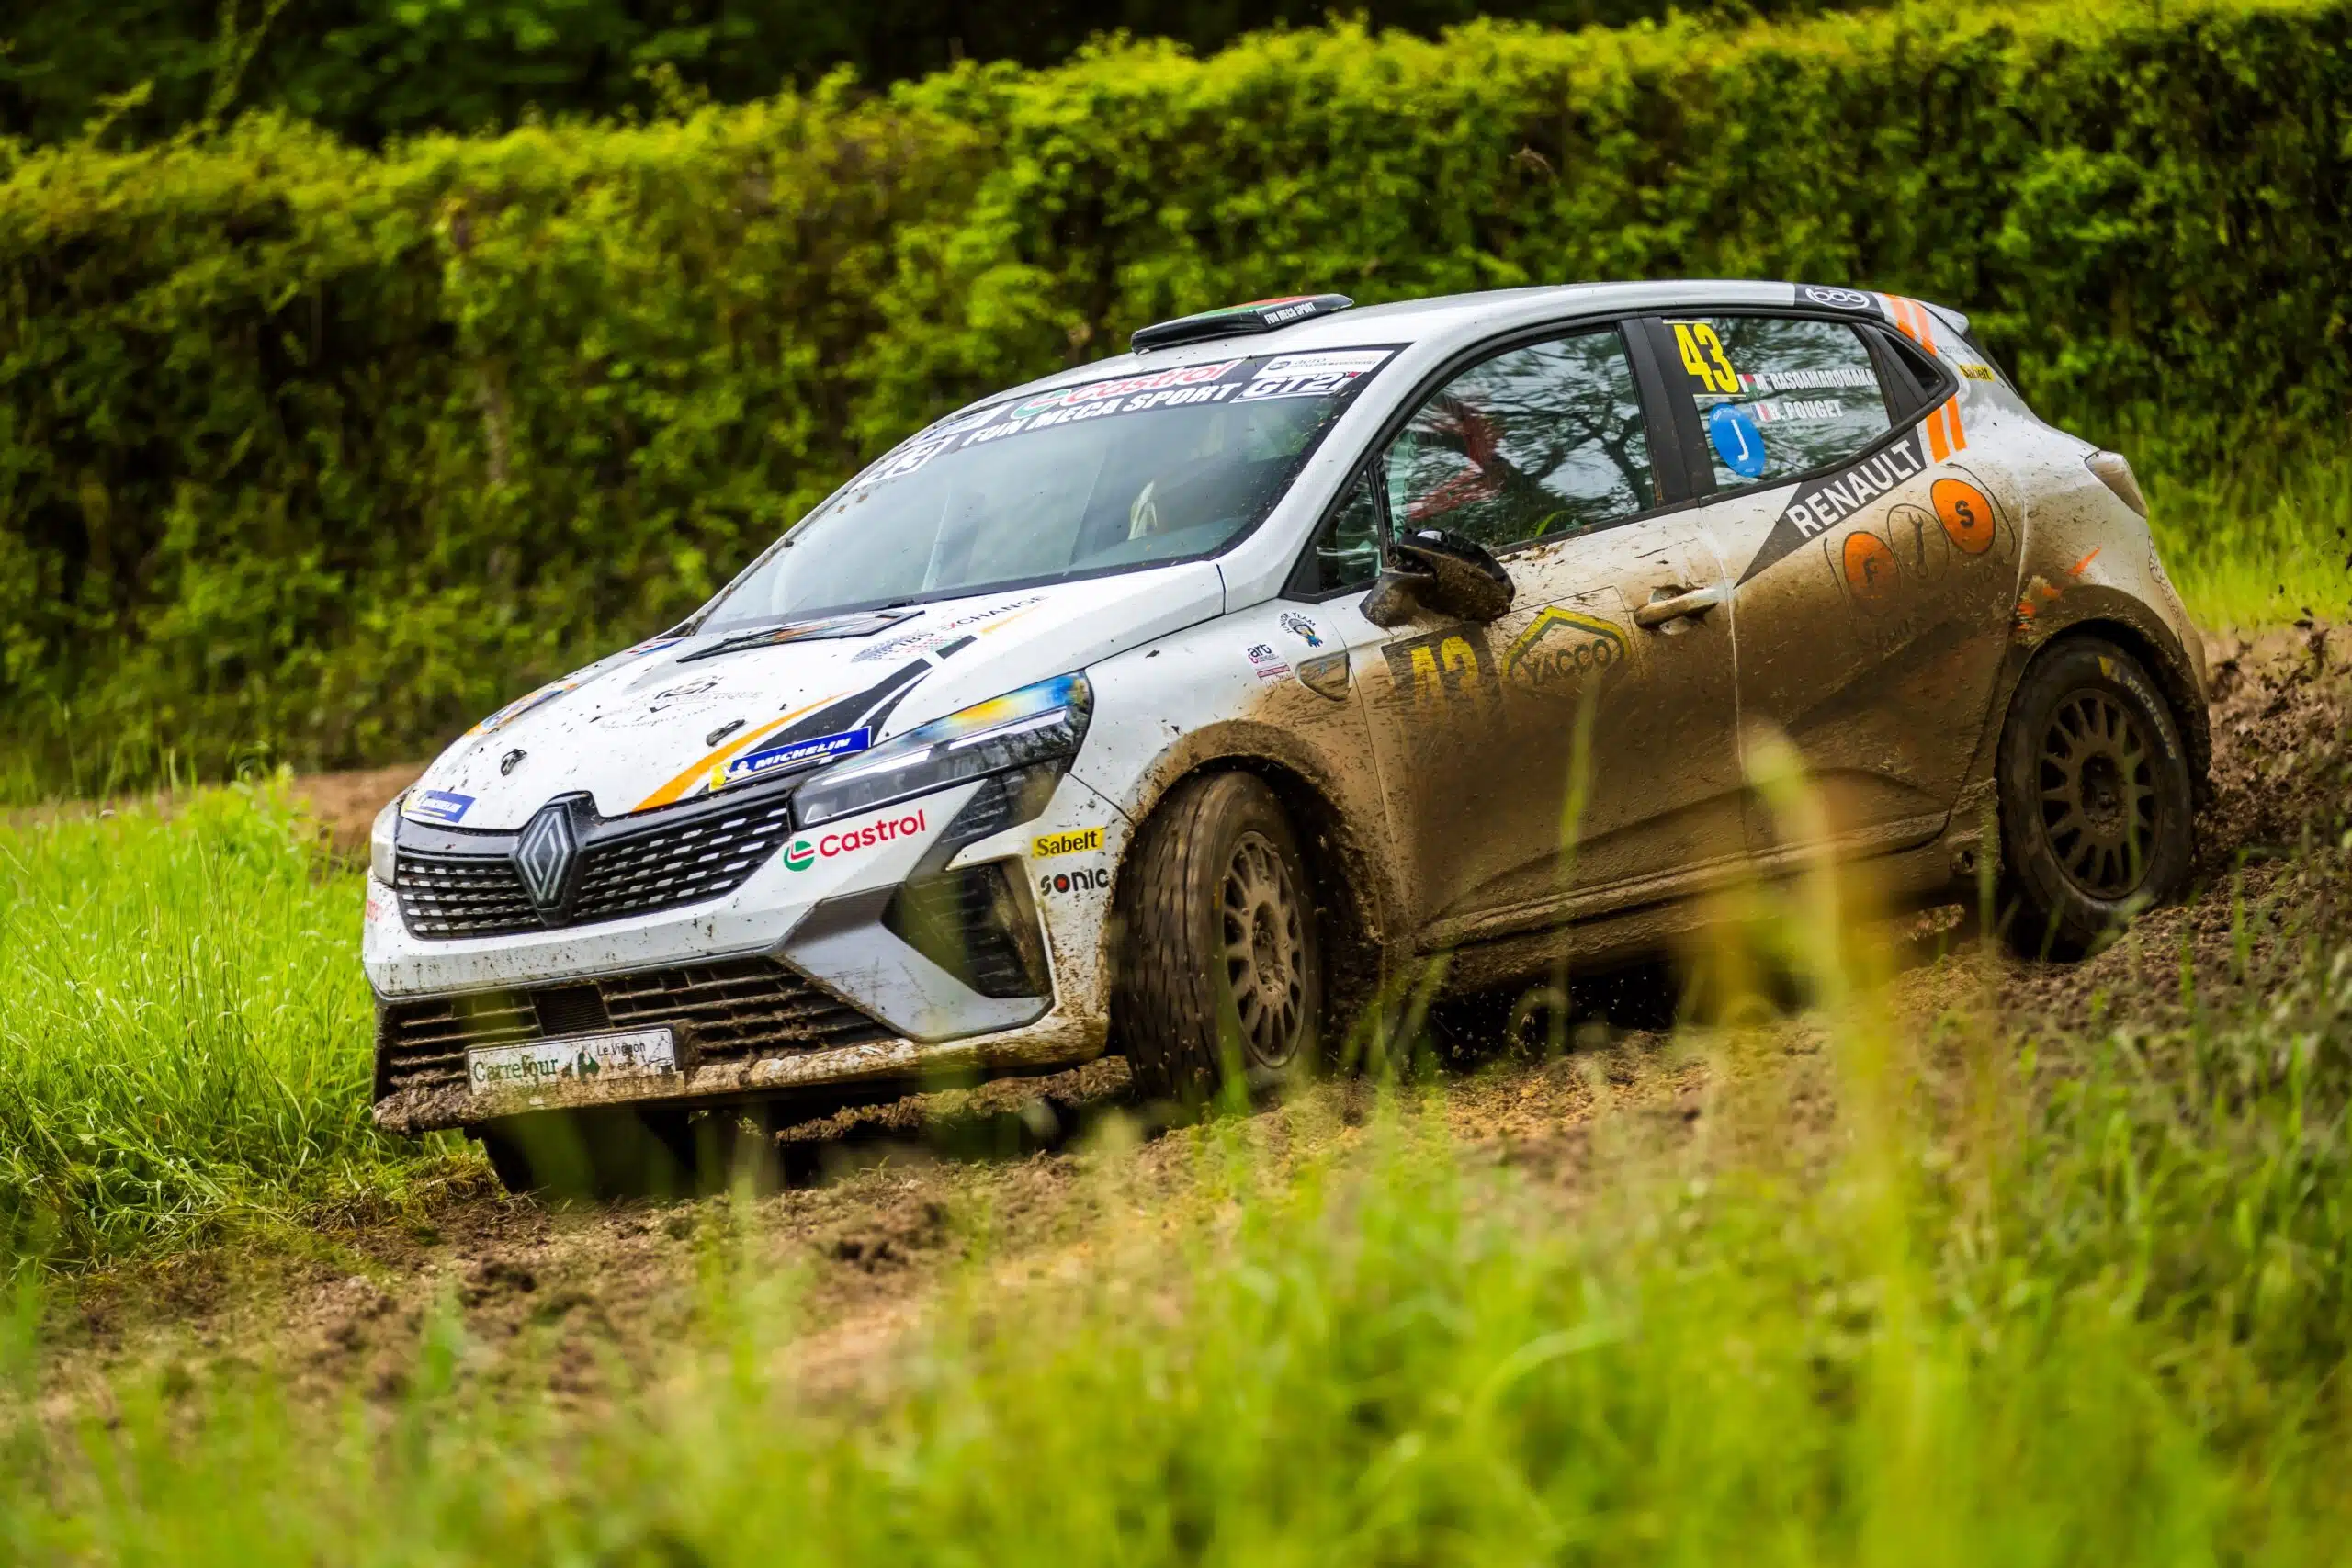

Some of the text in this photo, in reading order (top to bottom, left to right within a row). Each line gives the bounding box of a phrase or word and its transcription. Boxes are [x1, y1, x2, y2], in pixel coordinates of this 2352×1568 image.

[1277, 307, 1297, 321] MECA
[1294, 302, 1317, 316] SPORT
[1673, 323, 1740, 393] 43
[1064, 359, 1238, 402] Castrol
[1241, 371, 1362, 399] GT2i
[1753, 373, 1772, 390] M.
[1959, 365, 1991, 380] Sabelt
[961, 418, 1025, 447] FUN
[1024, 398, 1125, 431] MECA
[1122, 382, 1243, 412] SPORT
[1782, 400, 1843, 420] POUGET
[1730, 419, 1749, 461] J
[1785, 439, 1925, 539] RENAULT
[1953, 500, 1975, 529] S
[1292, 612, 1317, 626] TEAM
[754, 738, 852, 769] MICHELIN
[820, 808, 926, 857] Castrol
[1036, 830, 1098, 857] Sabelt
[1040, 868, 1109, 896] sonic
[473, 1055, 559, 1083] Carrefour
